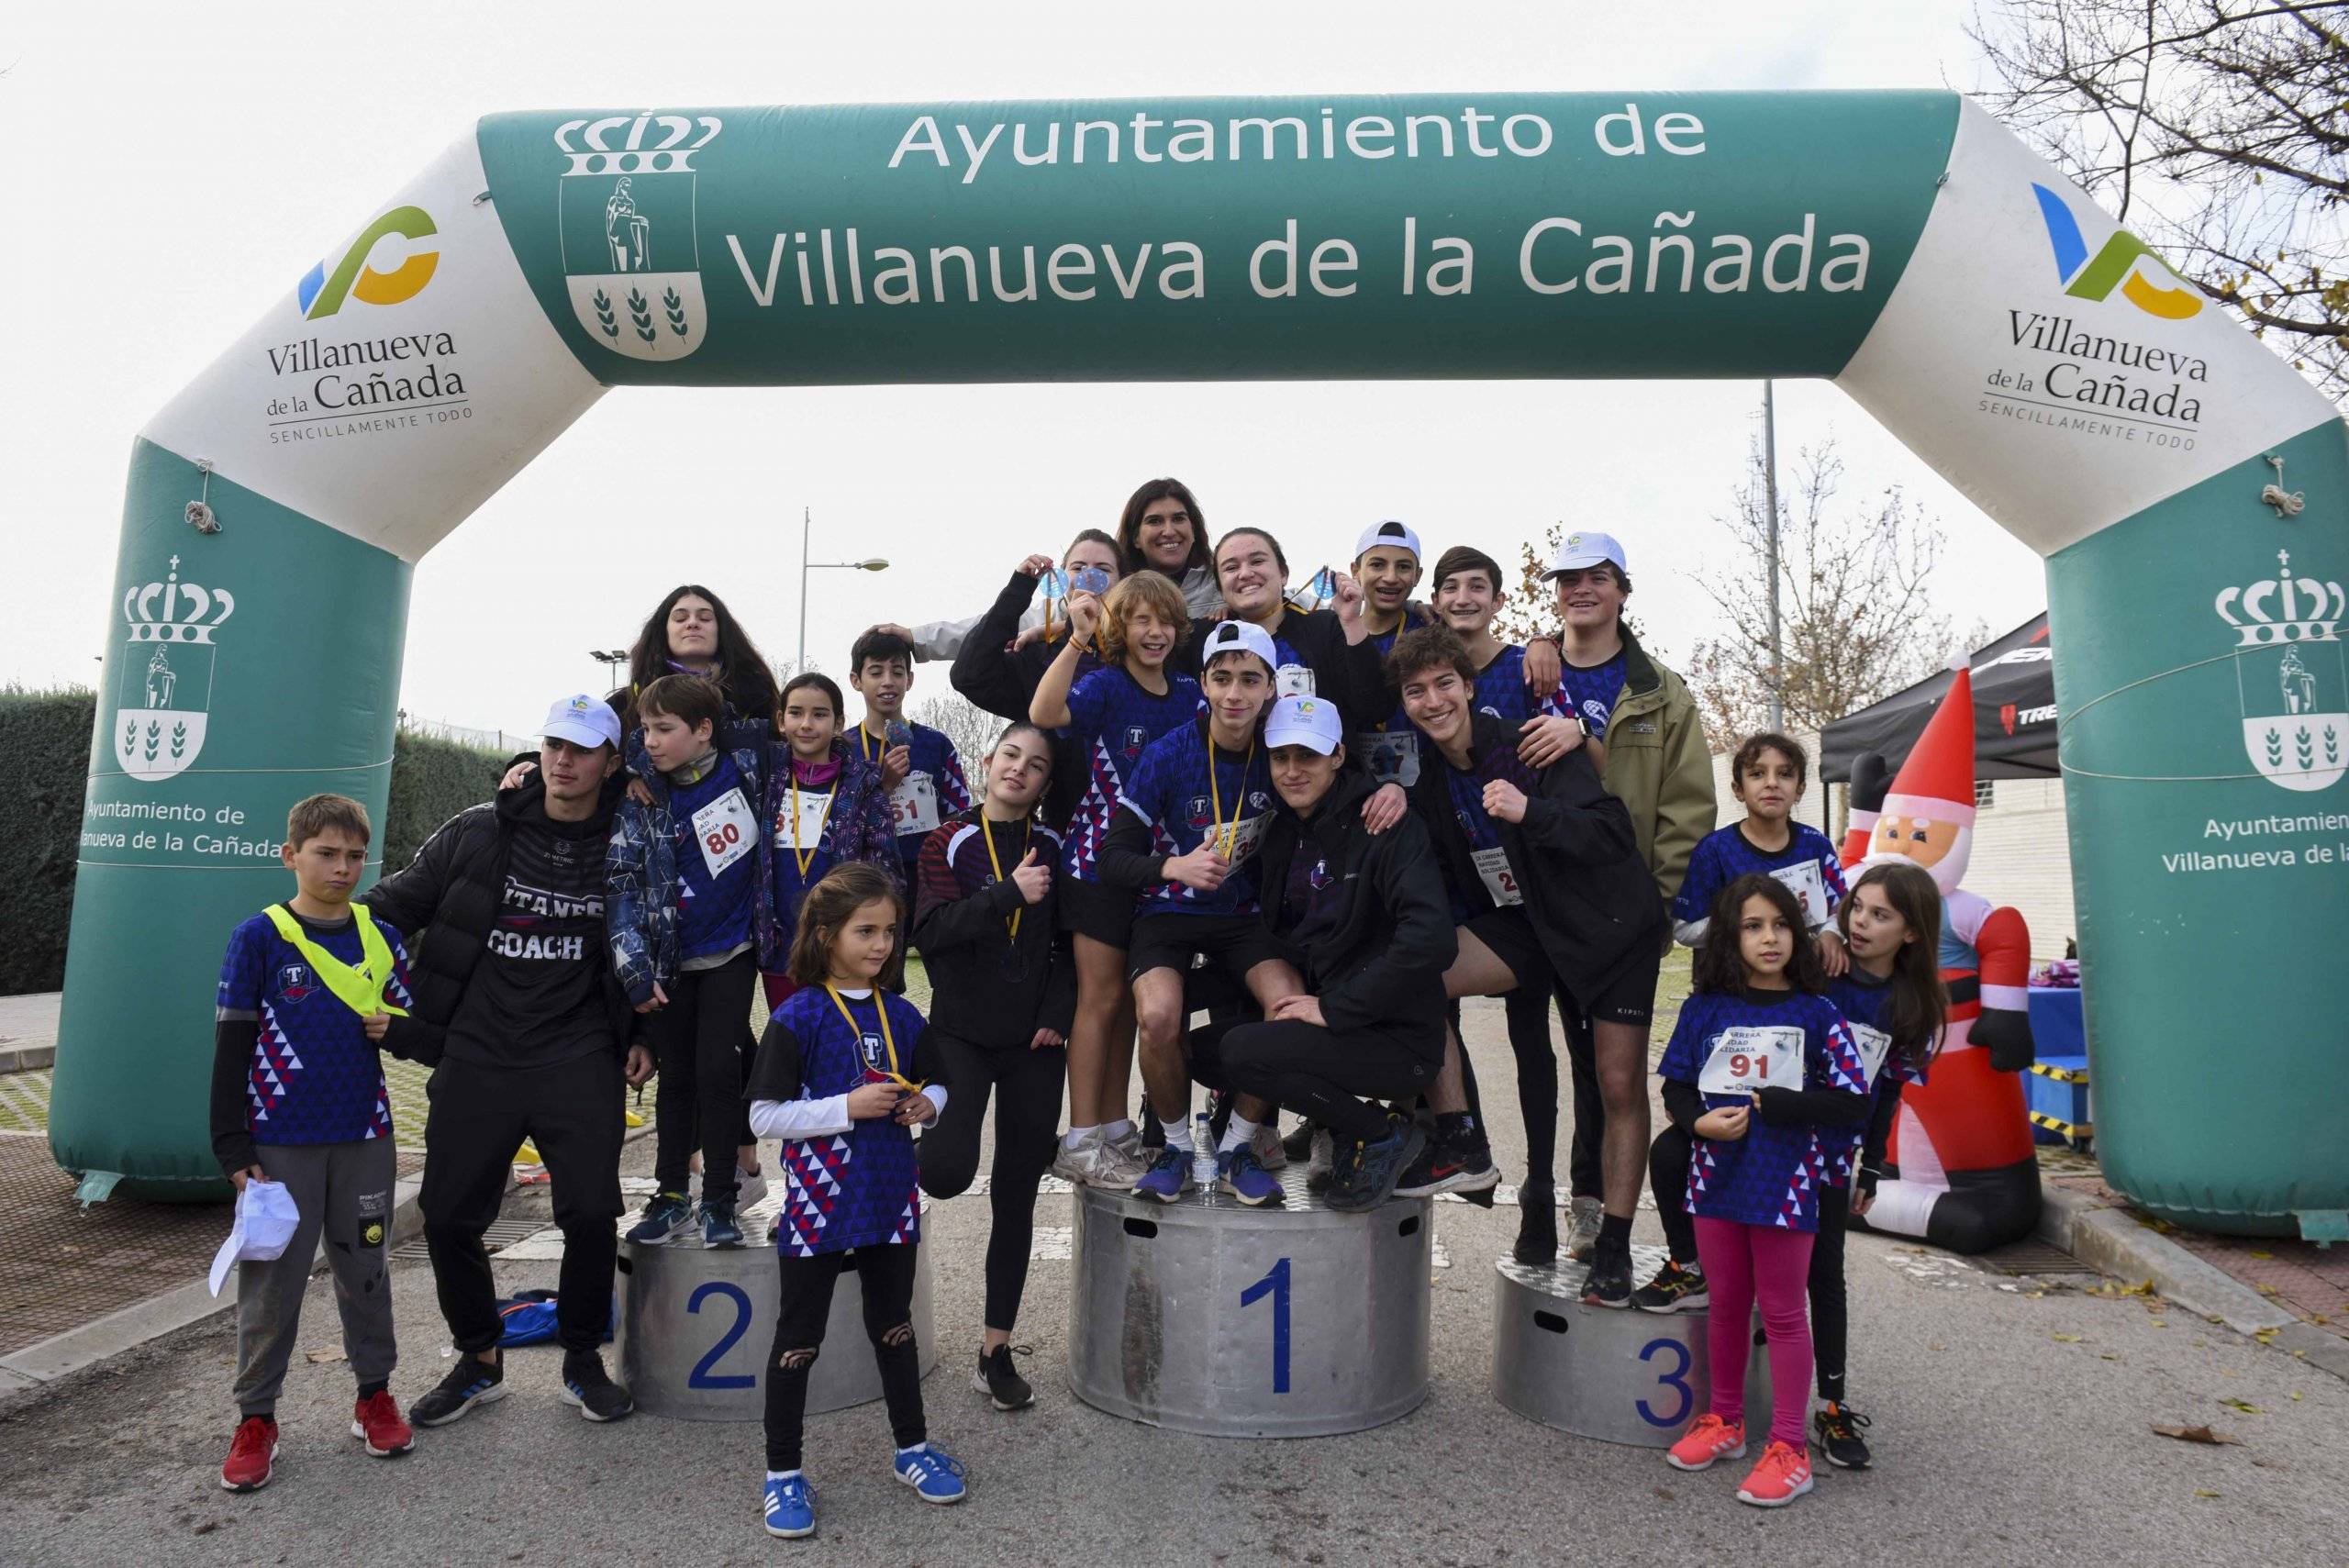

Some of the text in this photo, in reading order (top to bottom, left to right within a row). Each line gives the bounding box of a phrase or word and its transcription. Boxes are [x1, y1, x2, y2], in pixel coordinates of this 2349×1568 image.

[887, 103, 1706, 183] Ayuntamiento de
[726, 210, 1871, 306] Villanueva de la Cañada
[267, 331, 458, 376] Villanueva
[2008, 308, 2208, 383] Villanueva
[267, 363, 467, 416] de la Cañada
[1987, 362, 2201, 424] de la Cañada
[270, 407, 473, 444] SENCILLAMENTE TODO
[1978, 399, 2196, 451] SENCILLAMENTE TODO
[87, 799, 245, 825] Ayuntamiento de
[132, 830, 157, 850] de
[164, 832, 184, 851] la
[193, 834, 284, 858] Cañada
[706, 823, 740, 855] 80
[2162, 850, 2296, 873] Villanueva
[2304, 844, 2333, 864] de
[1498, 872, 1518, 893] 2
[487, 929, 584, 961] COACH
[286, 966, 302, 983] T
[863, 1037, 880, 1061] T
[1730, 1054, 1768, 1080] 91
[686, 1281, 756, 1389] 2
[1241, 1257, 1291, 1394] 1
[1635, 1338, 1694, 1428] 3
